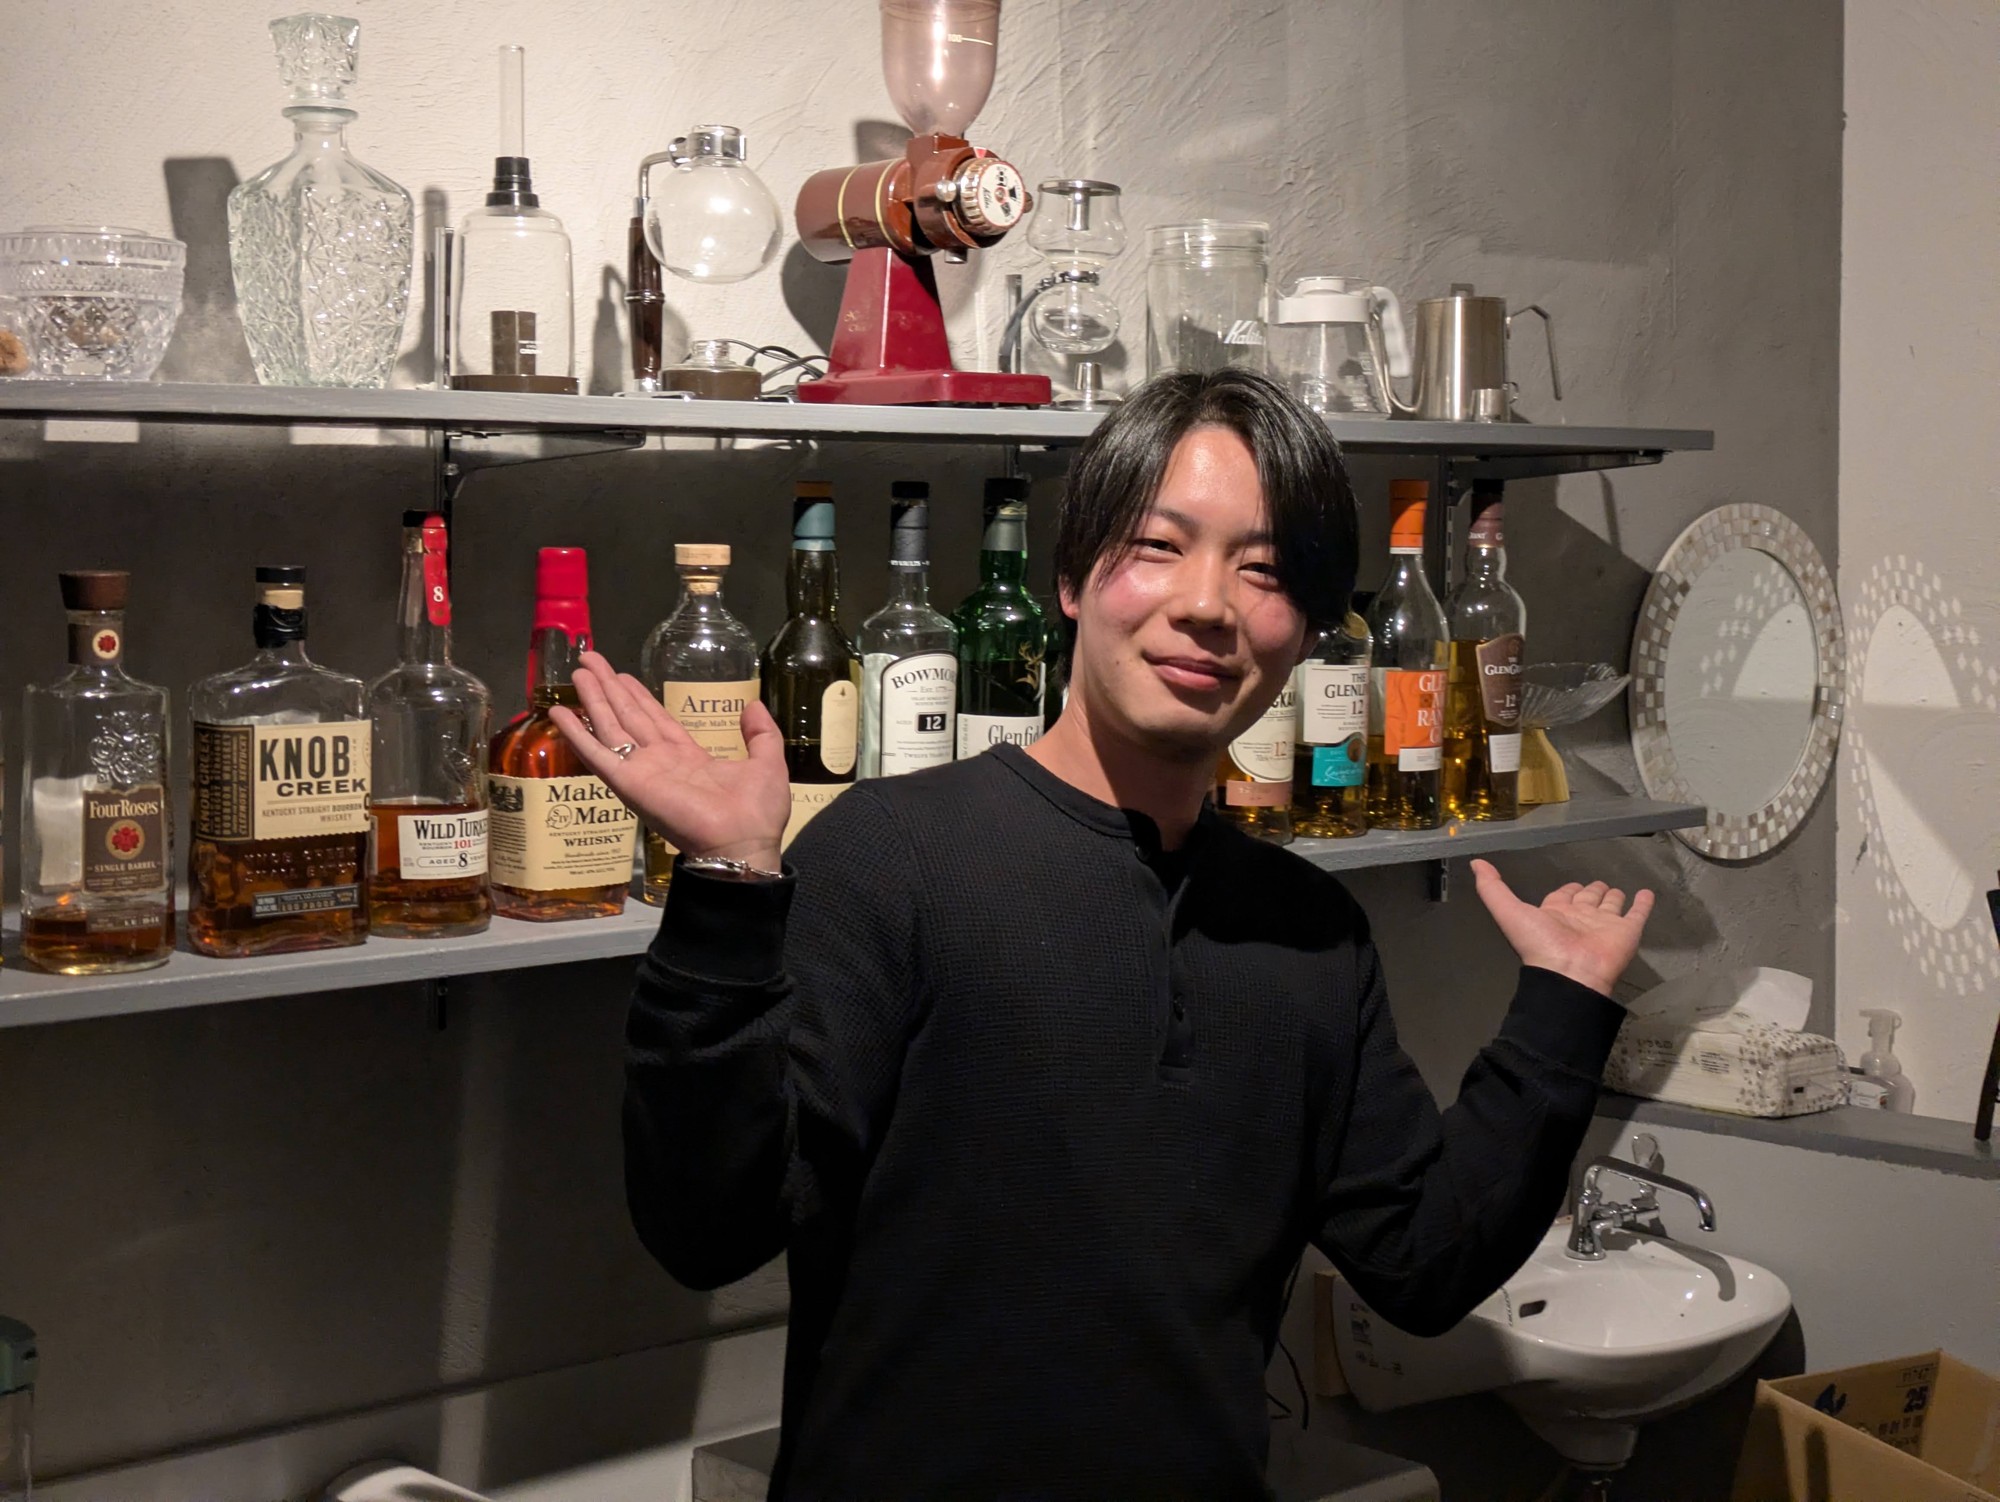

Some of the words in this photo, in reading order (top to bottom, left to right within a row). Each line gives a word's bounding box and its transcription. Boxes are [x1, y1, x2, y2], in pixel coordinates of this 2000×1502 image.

[433, 586, 444, 601] 8
[681, 695, 745, 713] Arran
[1352, 700, 1363, 714] 12
[925, 716, 942, 730] 12
[1274, 742, 1288, 757] 12
[260, 736, 350, 782] KNOB
[277, 778, 366, 797] CREEK
[545, 784, 617, 802] Make
[89, 801, 120, 818] Four
[120, 800, 158, 817] Roses
[262, 807, 297, 817] KENTUCKY
[299, 805, 330, 814] STRAIGHT
[332, 803, 362, 812] BOURBON
[320, 814, 352, 822] WHISKEY
[414, 820, 456, 839] WILD
[454, 839, 472, 849] 101
[563, 834, 624, 847] WHISKY
[458, 852, 468, 868] 8
